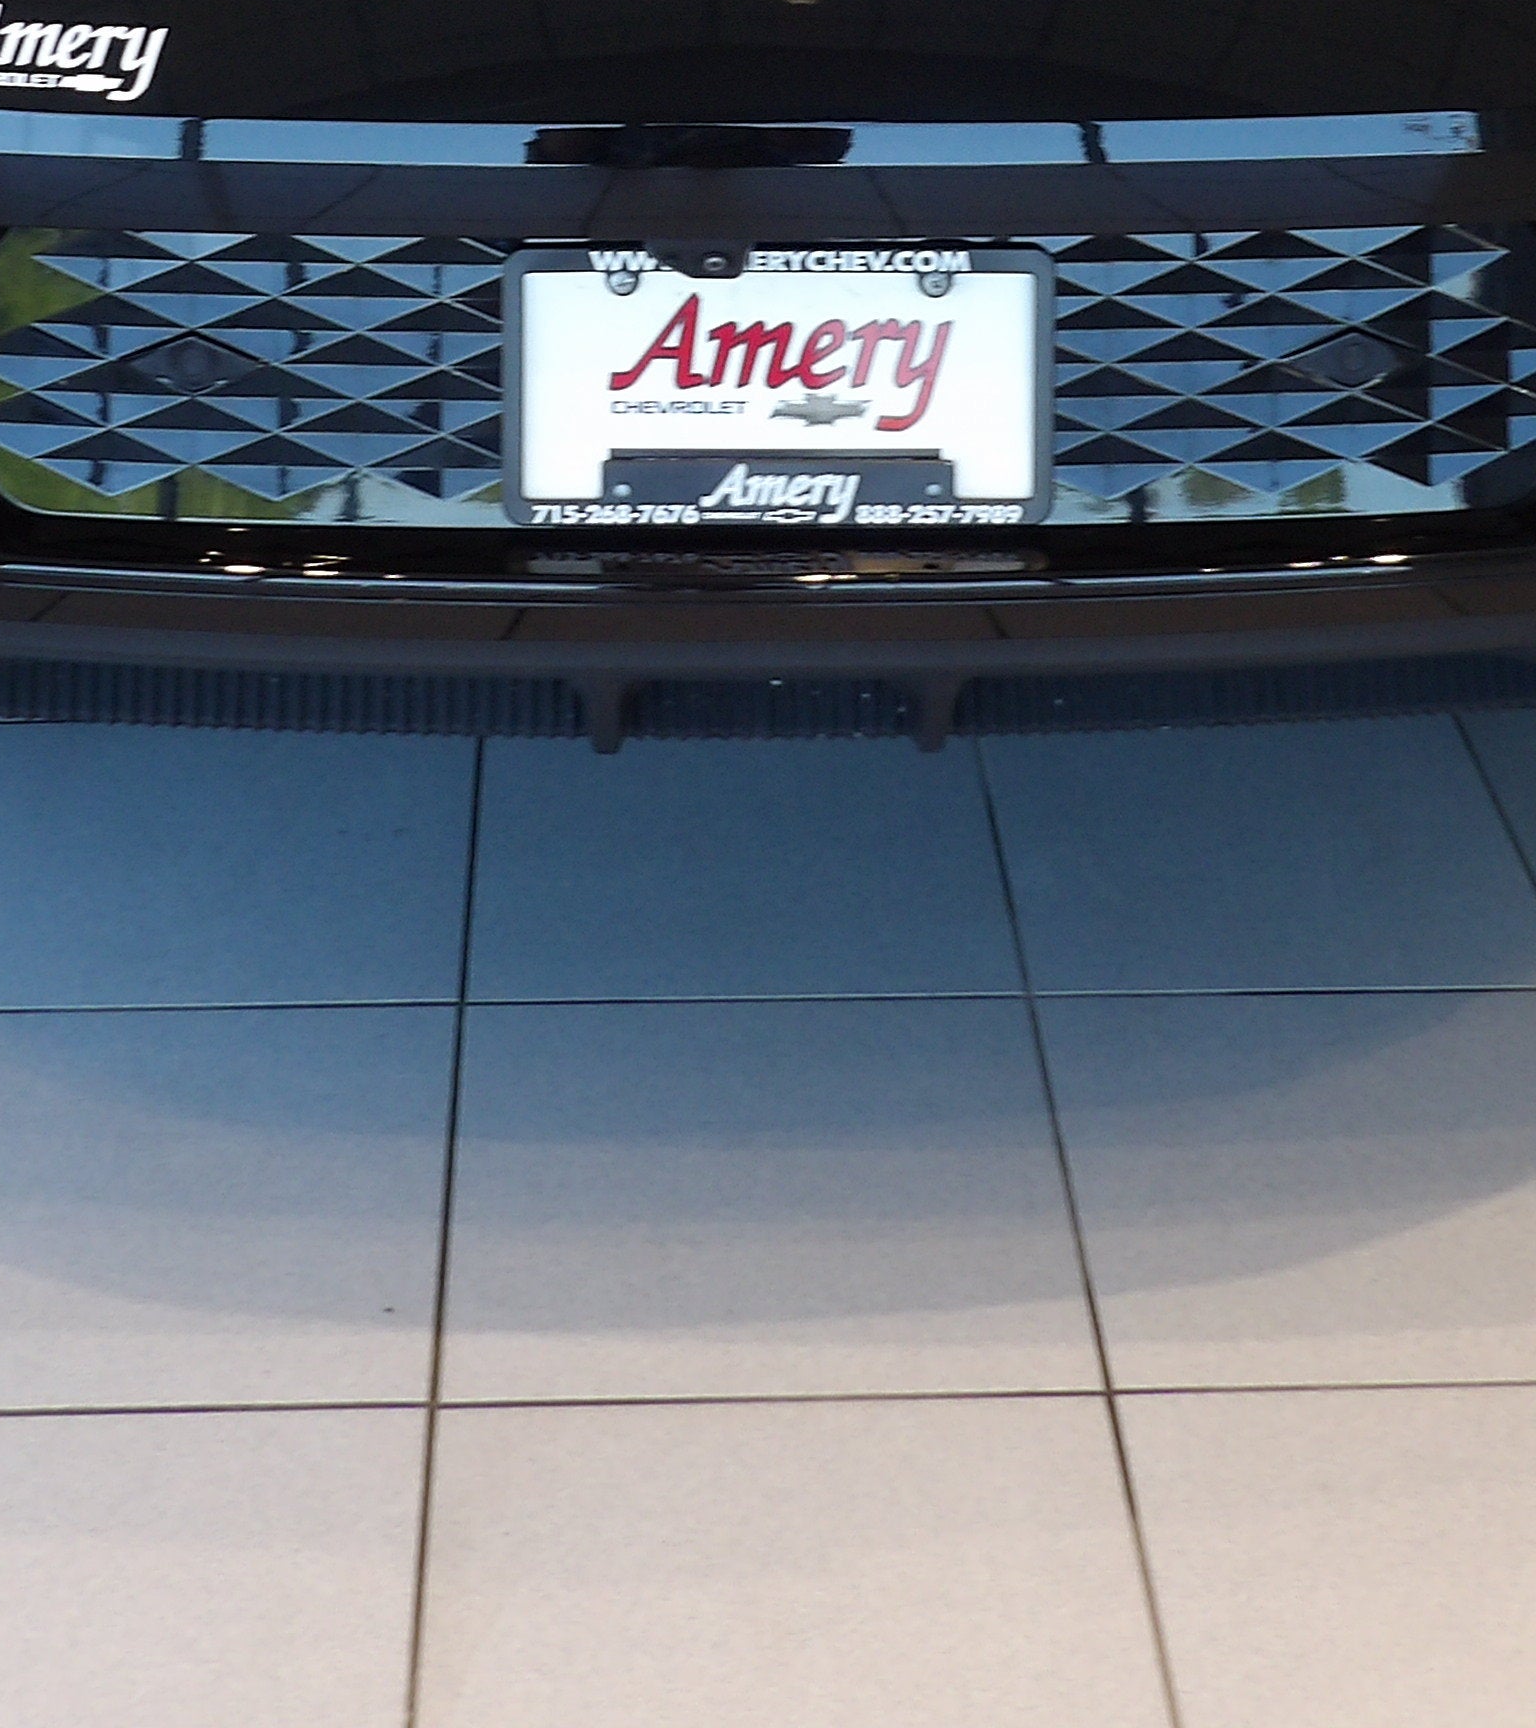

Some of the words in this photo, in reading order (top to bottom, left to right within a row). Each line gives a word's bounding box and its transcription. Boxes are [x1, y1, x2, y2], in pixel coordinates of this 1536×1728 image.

[609, 292, 954, 432] Amery
[610, 400, 749, 414] CHEVROLET
[698, 462, 861, 524] Amery
